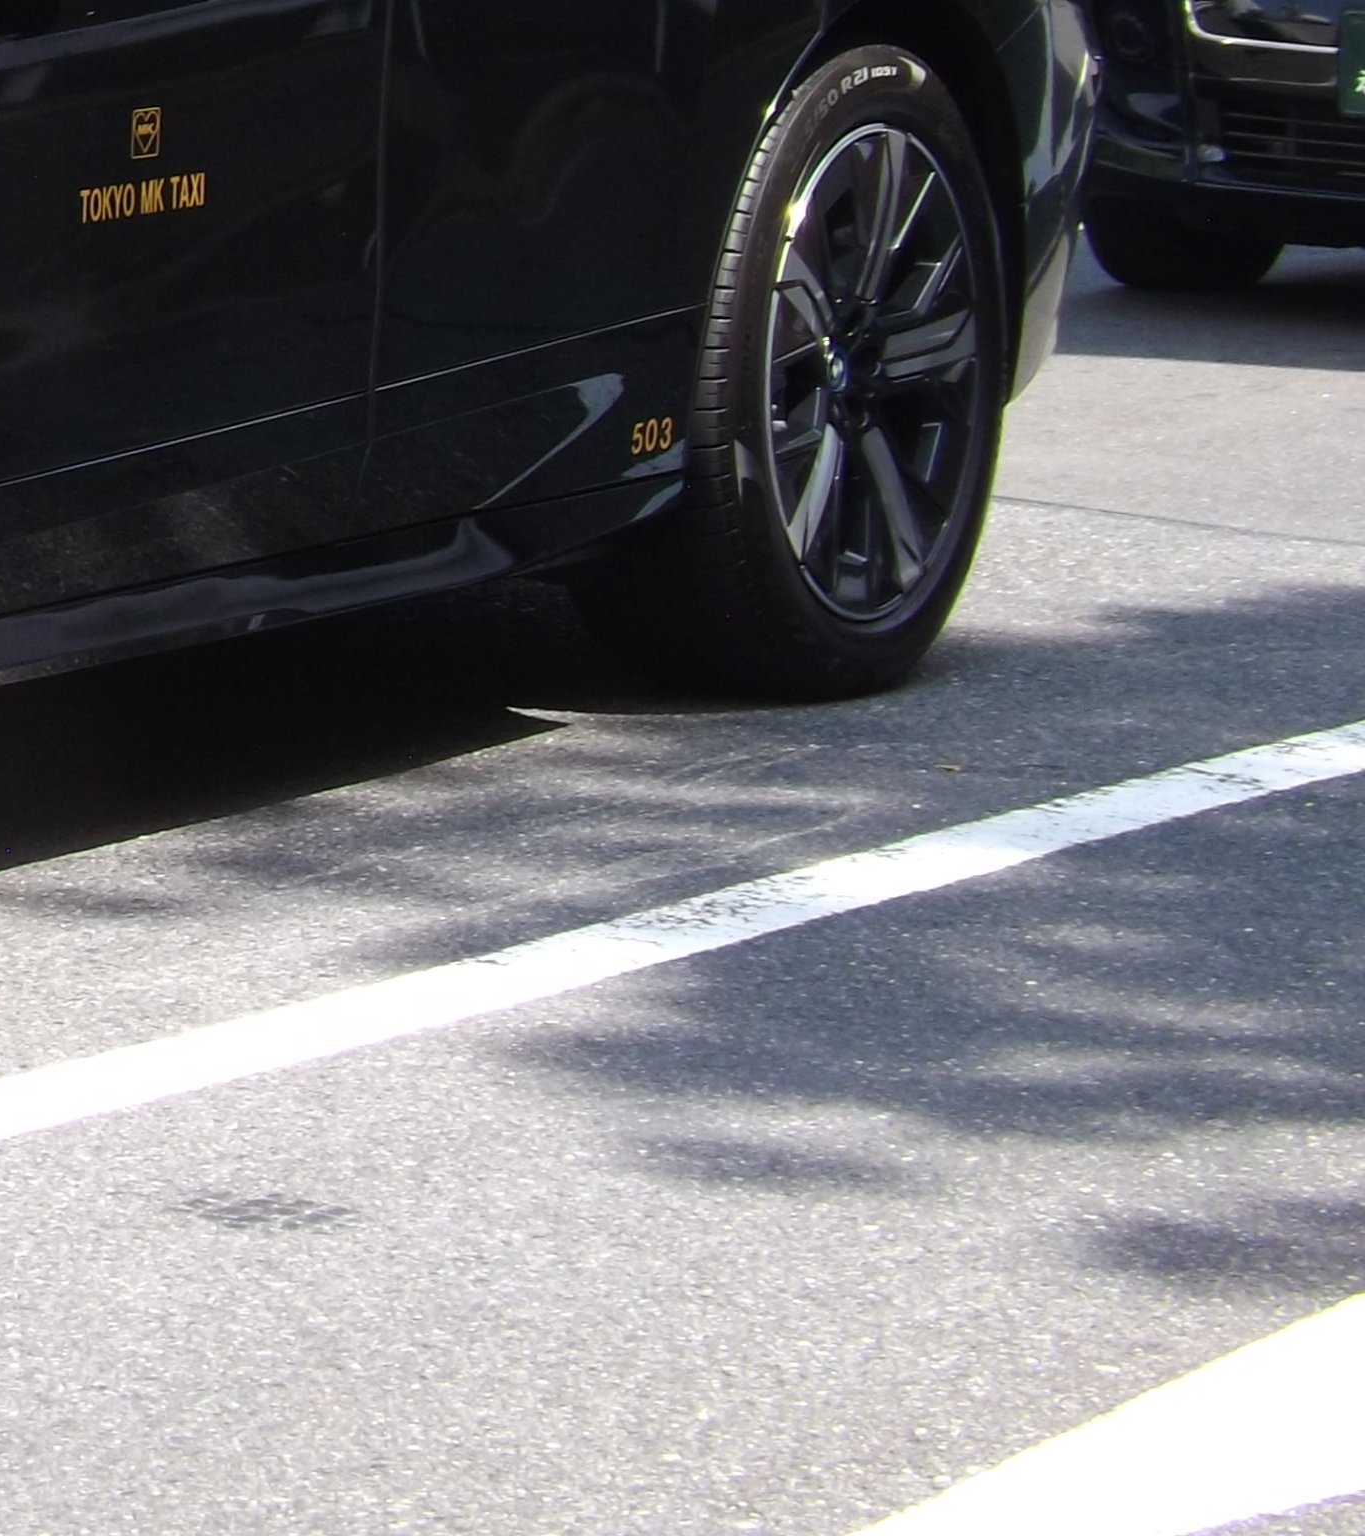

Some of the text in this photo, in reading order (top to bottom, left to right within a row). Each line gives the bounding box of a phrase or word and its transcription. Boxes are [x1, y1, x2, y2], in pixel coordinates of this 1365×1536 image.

[80, 172, 206, 224] TOKYO MK TAXI
[631, 416, 673, 455] 503
